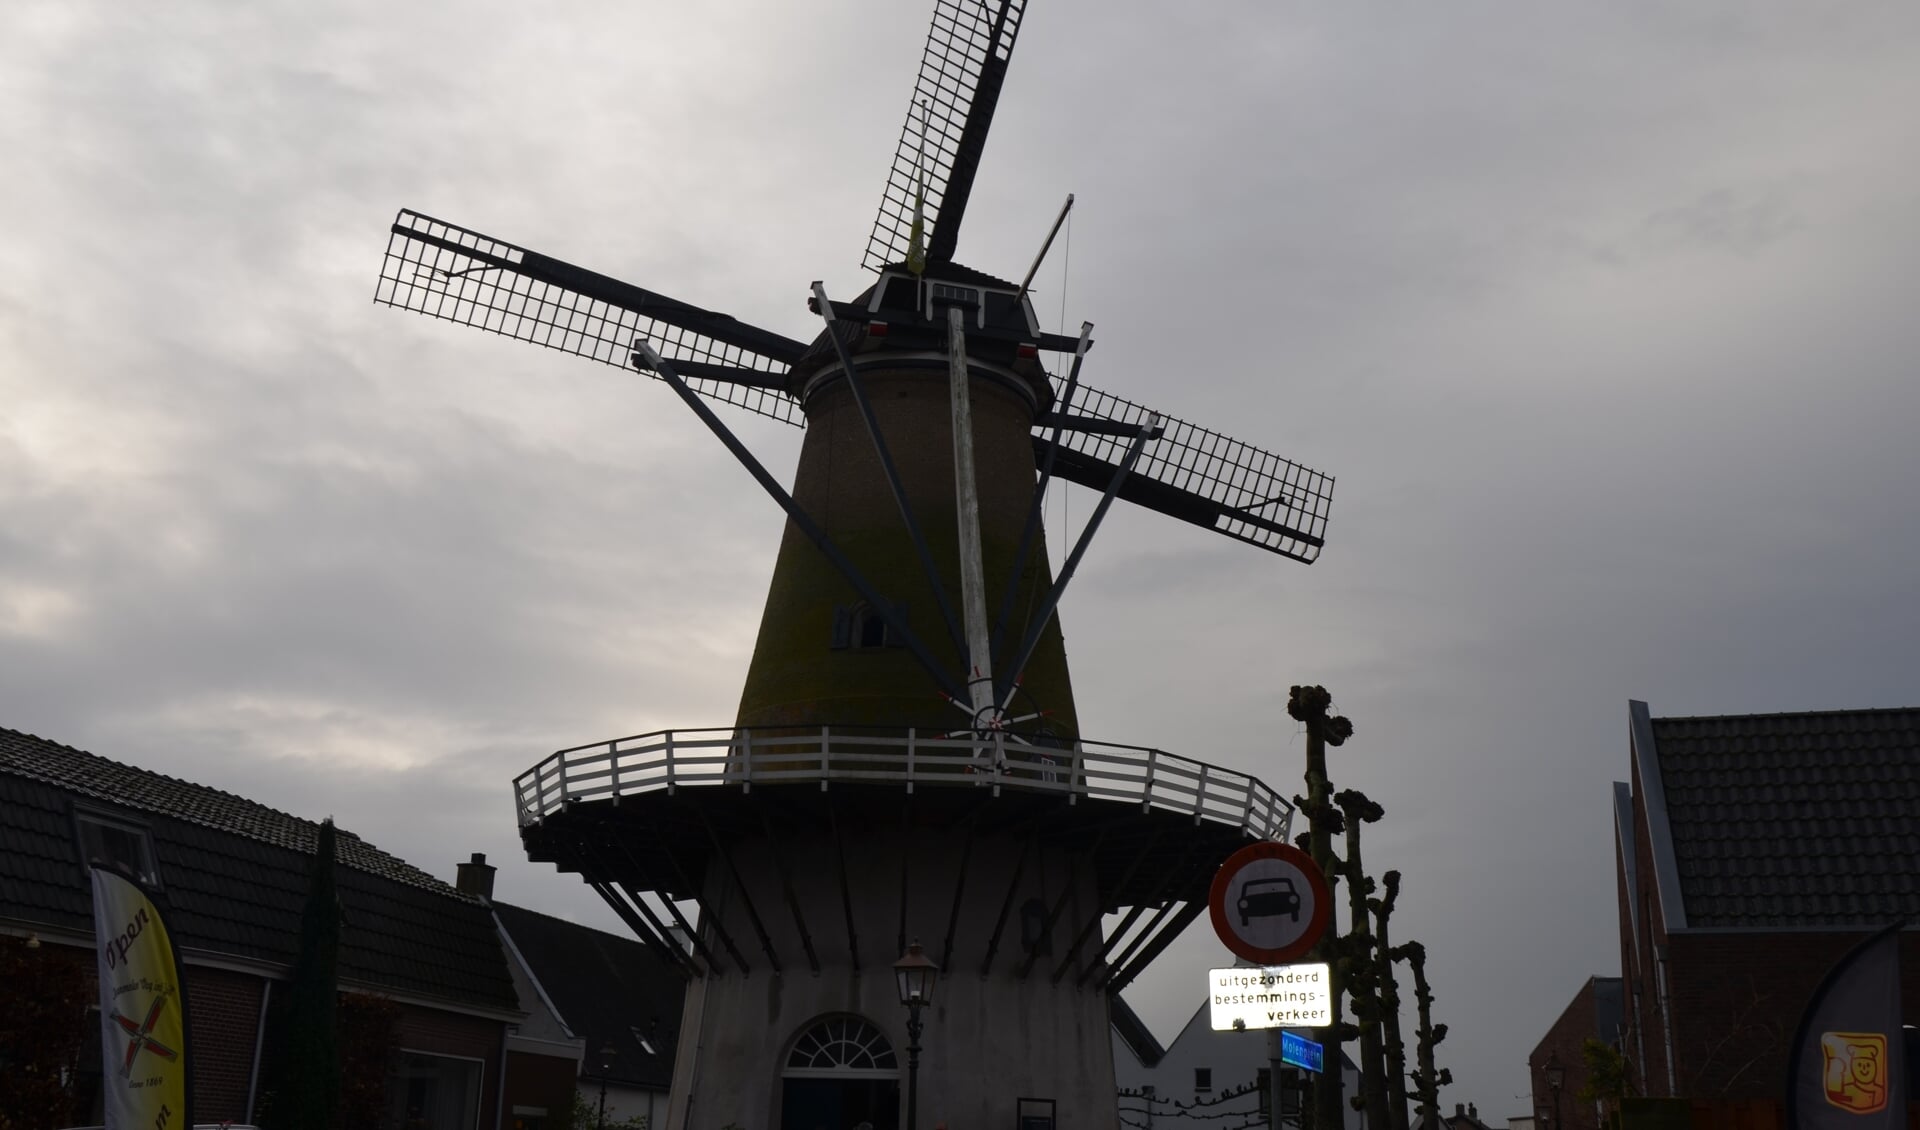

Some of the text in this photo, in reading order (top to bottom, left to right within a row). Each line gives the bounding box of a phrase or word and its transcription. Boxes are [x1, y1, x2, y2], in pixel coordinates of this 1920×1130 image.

[106, 908, 149, 970] Open
[1220, 972, 1318, 988] uitgezonderd
[1215, 991, 1325, 1005] bestemmings-
[1267, 1009, 1325, 1021] verkeer
[1283, 1038, 1320, 1061] Molenplein
